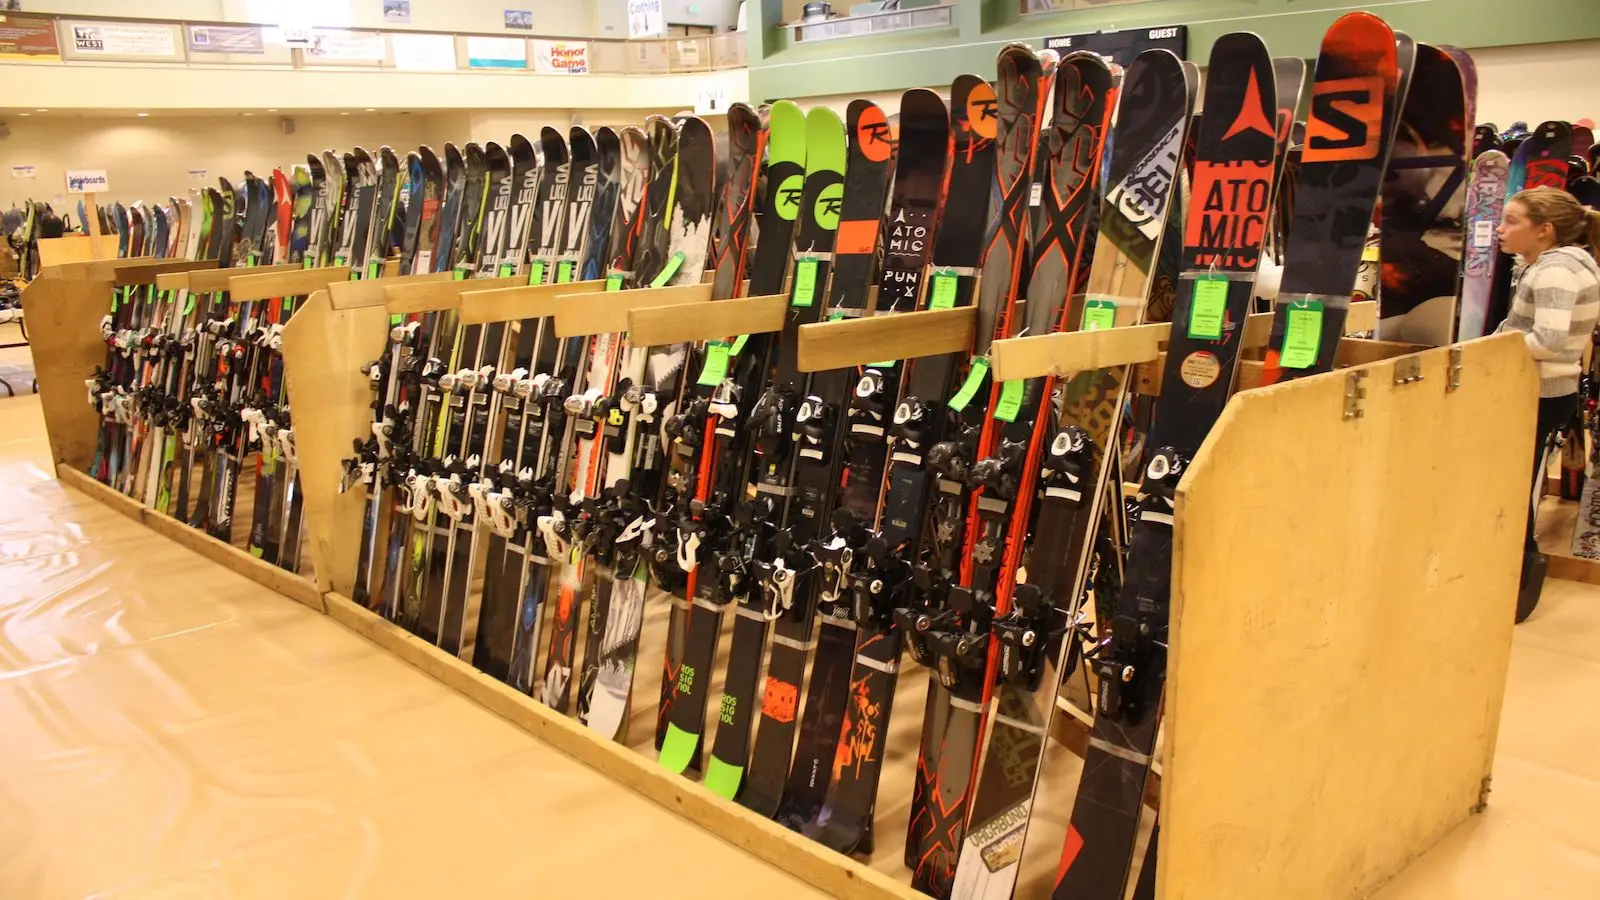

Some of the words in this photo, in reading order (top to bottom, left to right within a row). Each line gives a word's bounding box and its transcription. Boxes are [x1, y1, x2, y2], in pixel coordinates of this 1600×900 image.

[629, 0, 660, 15] Clothing
[1148, 28, 1178, 39] GUEST
[76, 39, 104, 49] WEST
[1048, 38, 1072, 48] HOME
[551, 47, 585, 57] Honor
[551, 58, 585, 69] Game
[1203, 179, 1271, 213] ATO
[892, 225, 927, 238] ATO
[1198, 214, 1265, 250] MIC
[889, 239, 924, 252] MIC
[883, 270, 918, 283] PUN
